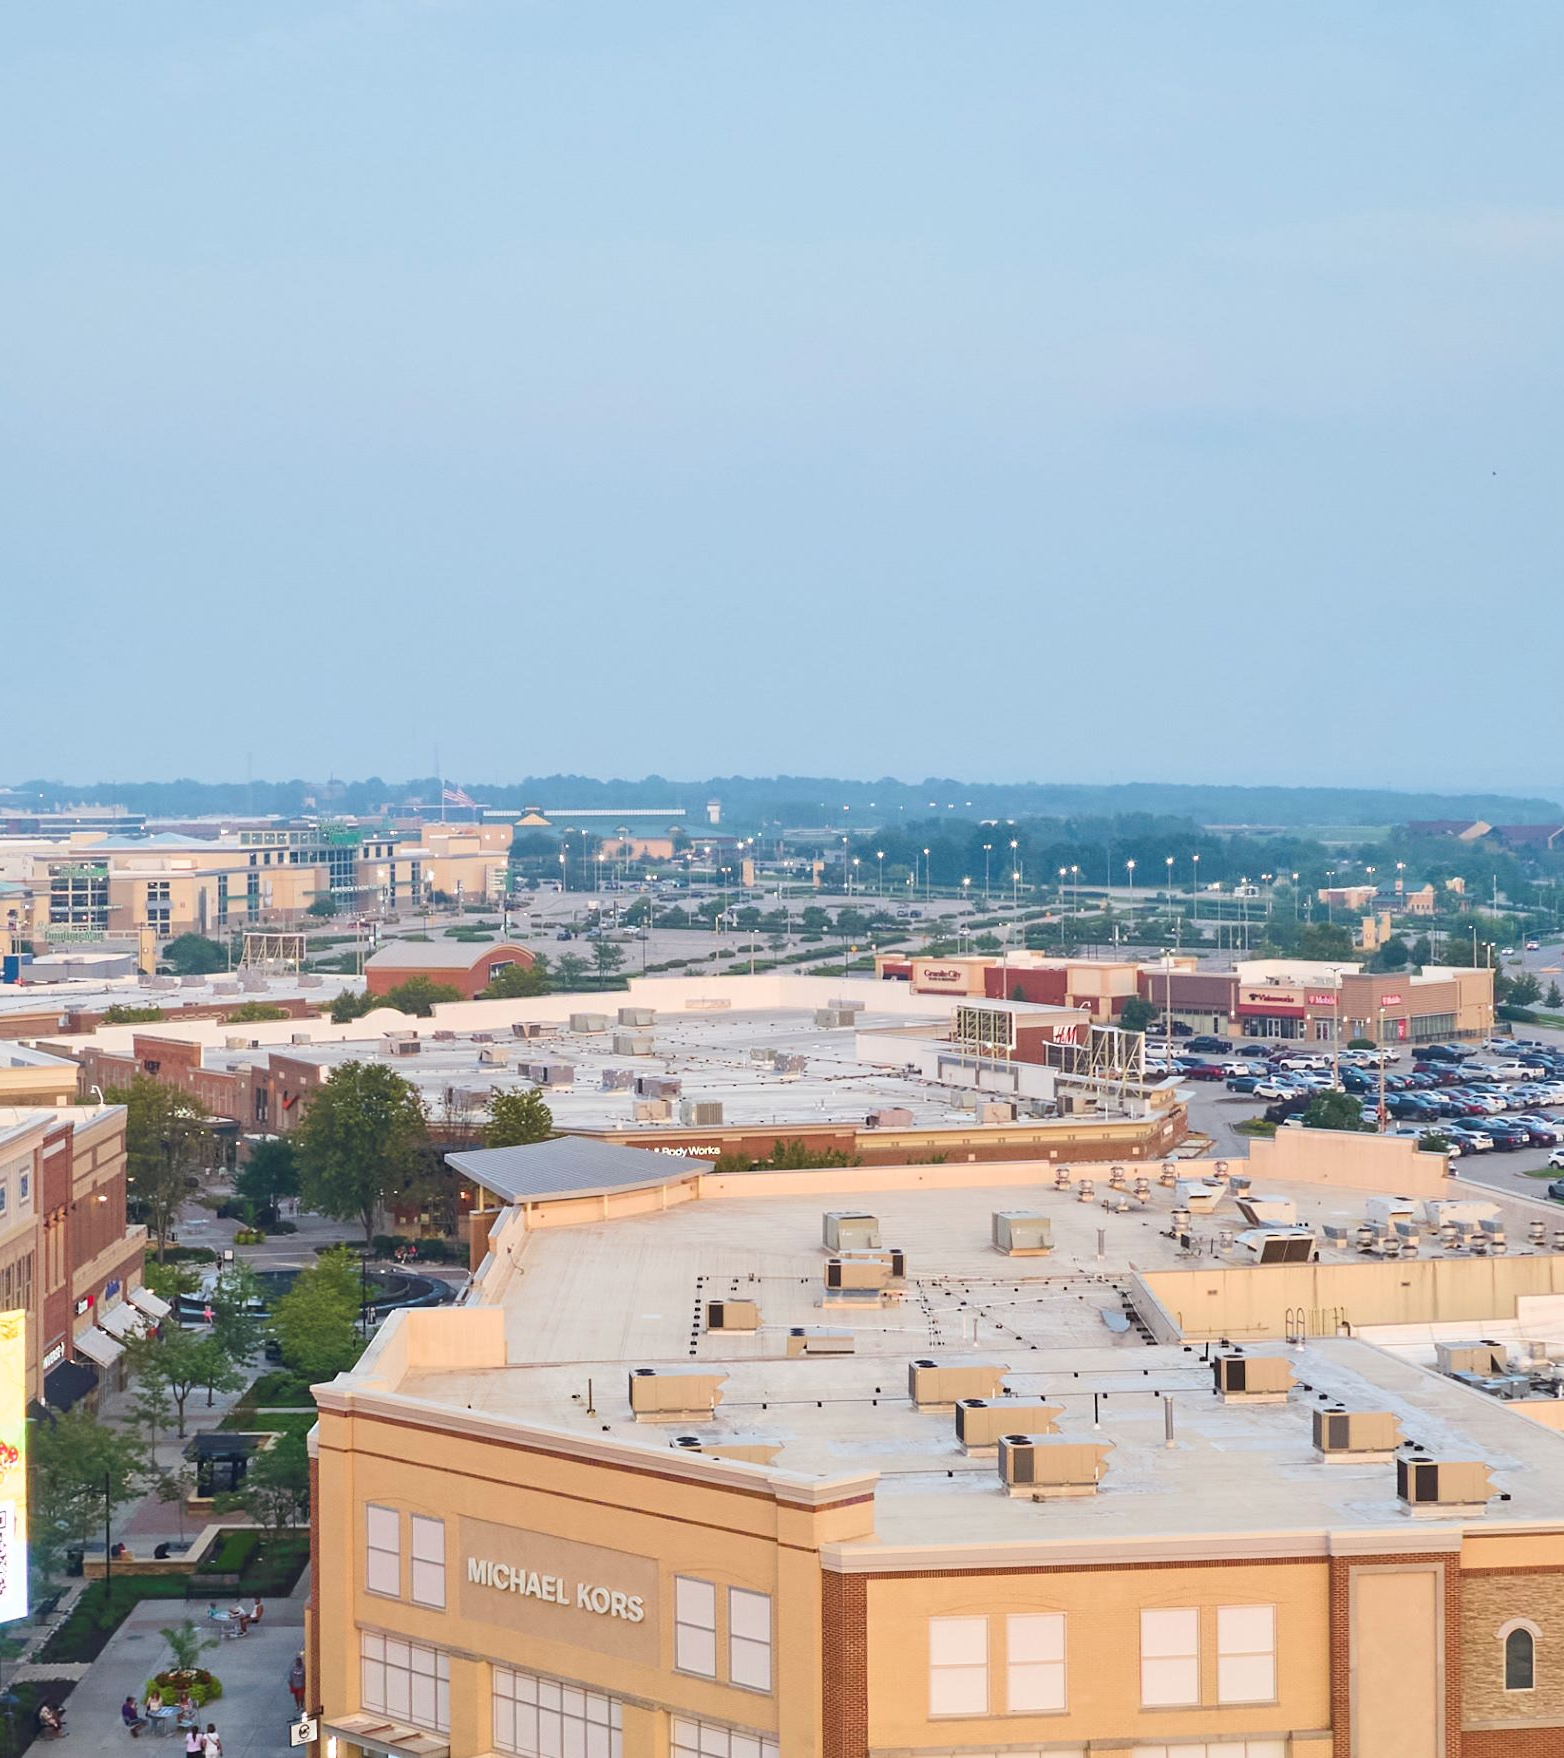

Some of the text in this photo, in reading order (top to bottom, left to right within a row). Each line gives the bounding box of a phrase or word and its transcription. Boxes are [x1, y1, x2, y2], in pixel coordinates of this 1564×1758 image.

[662, 1146, 687, 1157] Body
[689, 1146, 721, 1155] Works
[468, 1558, 644, 1622] MICHAEL KORS
